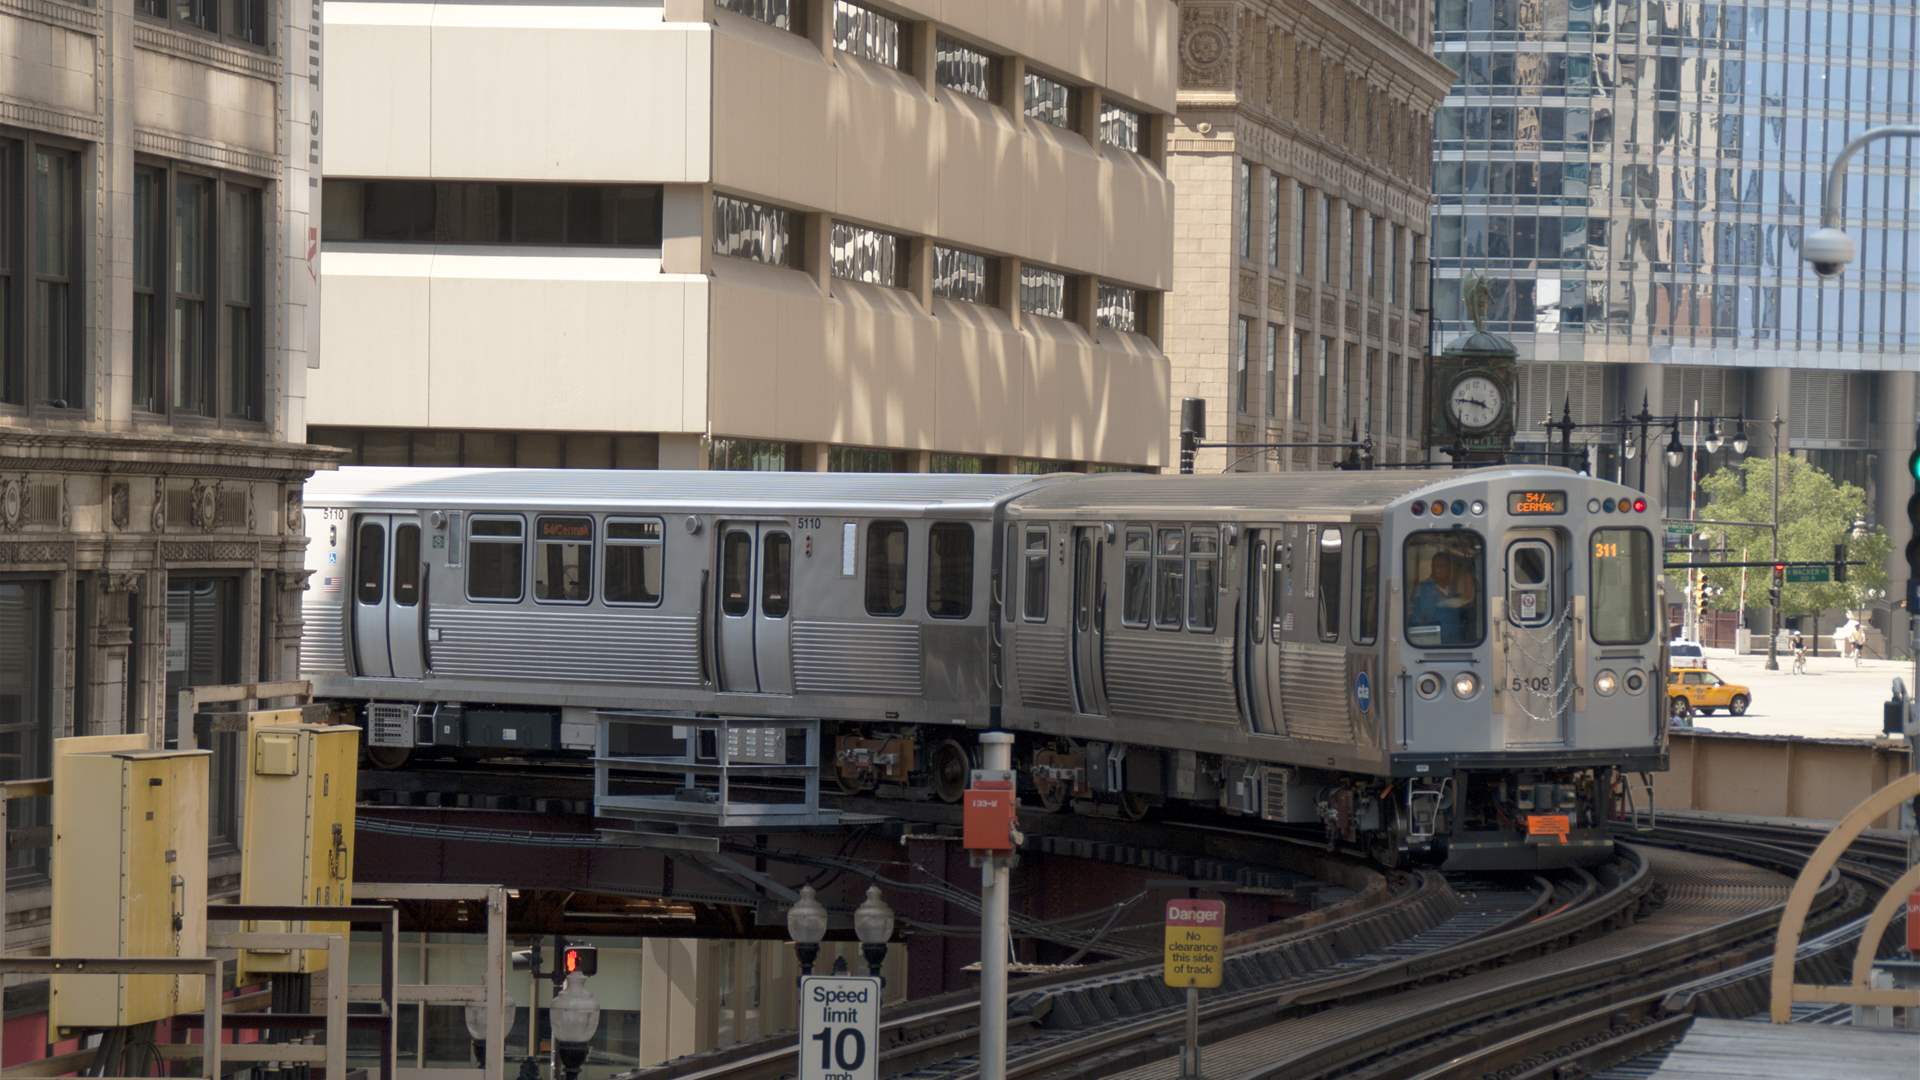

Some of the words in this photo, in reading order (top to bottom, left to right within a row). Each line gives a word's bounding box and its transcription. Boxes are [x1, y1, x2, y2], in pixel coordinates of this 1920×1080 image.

[1516, 502, 1555, 512] CERMAK
[323, 509, 344, 520] 5110
[798, 517, 821, 529] 5110
[1595, 543, 1617, 557] 311
[1169, 907, 1219, 923] Danger
[1186, 931, 1201, 941] No
[1169, 941, 1218, 952] clearance
[1173, 953, 1191, 962] this
[1193, 953, 1214, 962] side
[1174, 964, 1184, 974] of
[1187, 964, 1214, 974] track
[813, 986, 868, 1006] Speed
[823, 1007, 858, 1023] limit
[812, 1027, 866, 1071] 10
